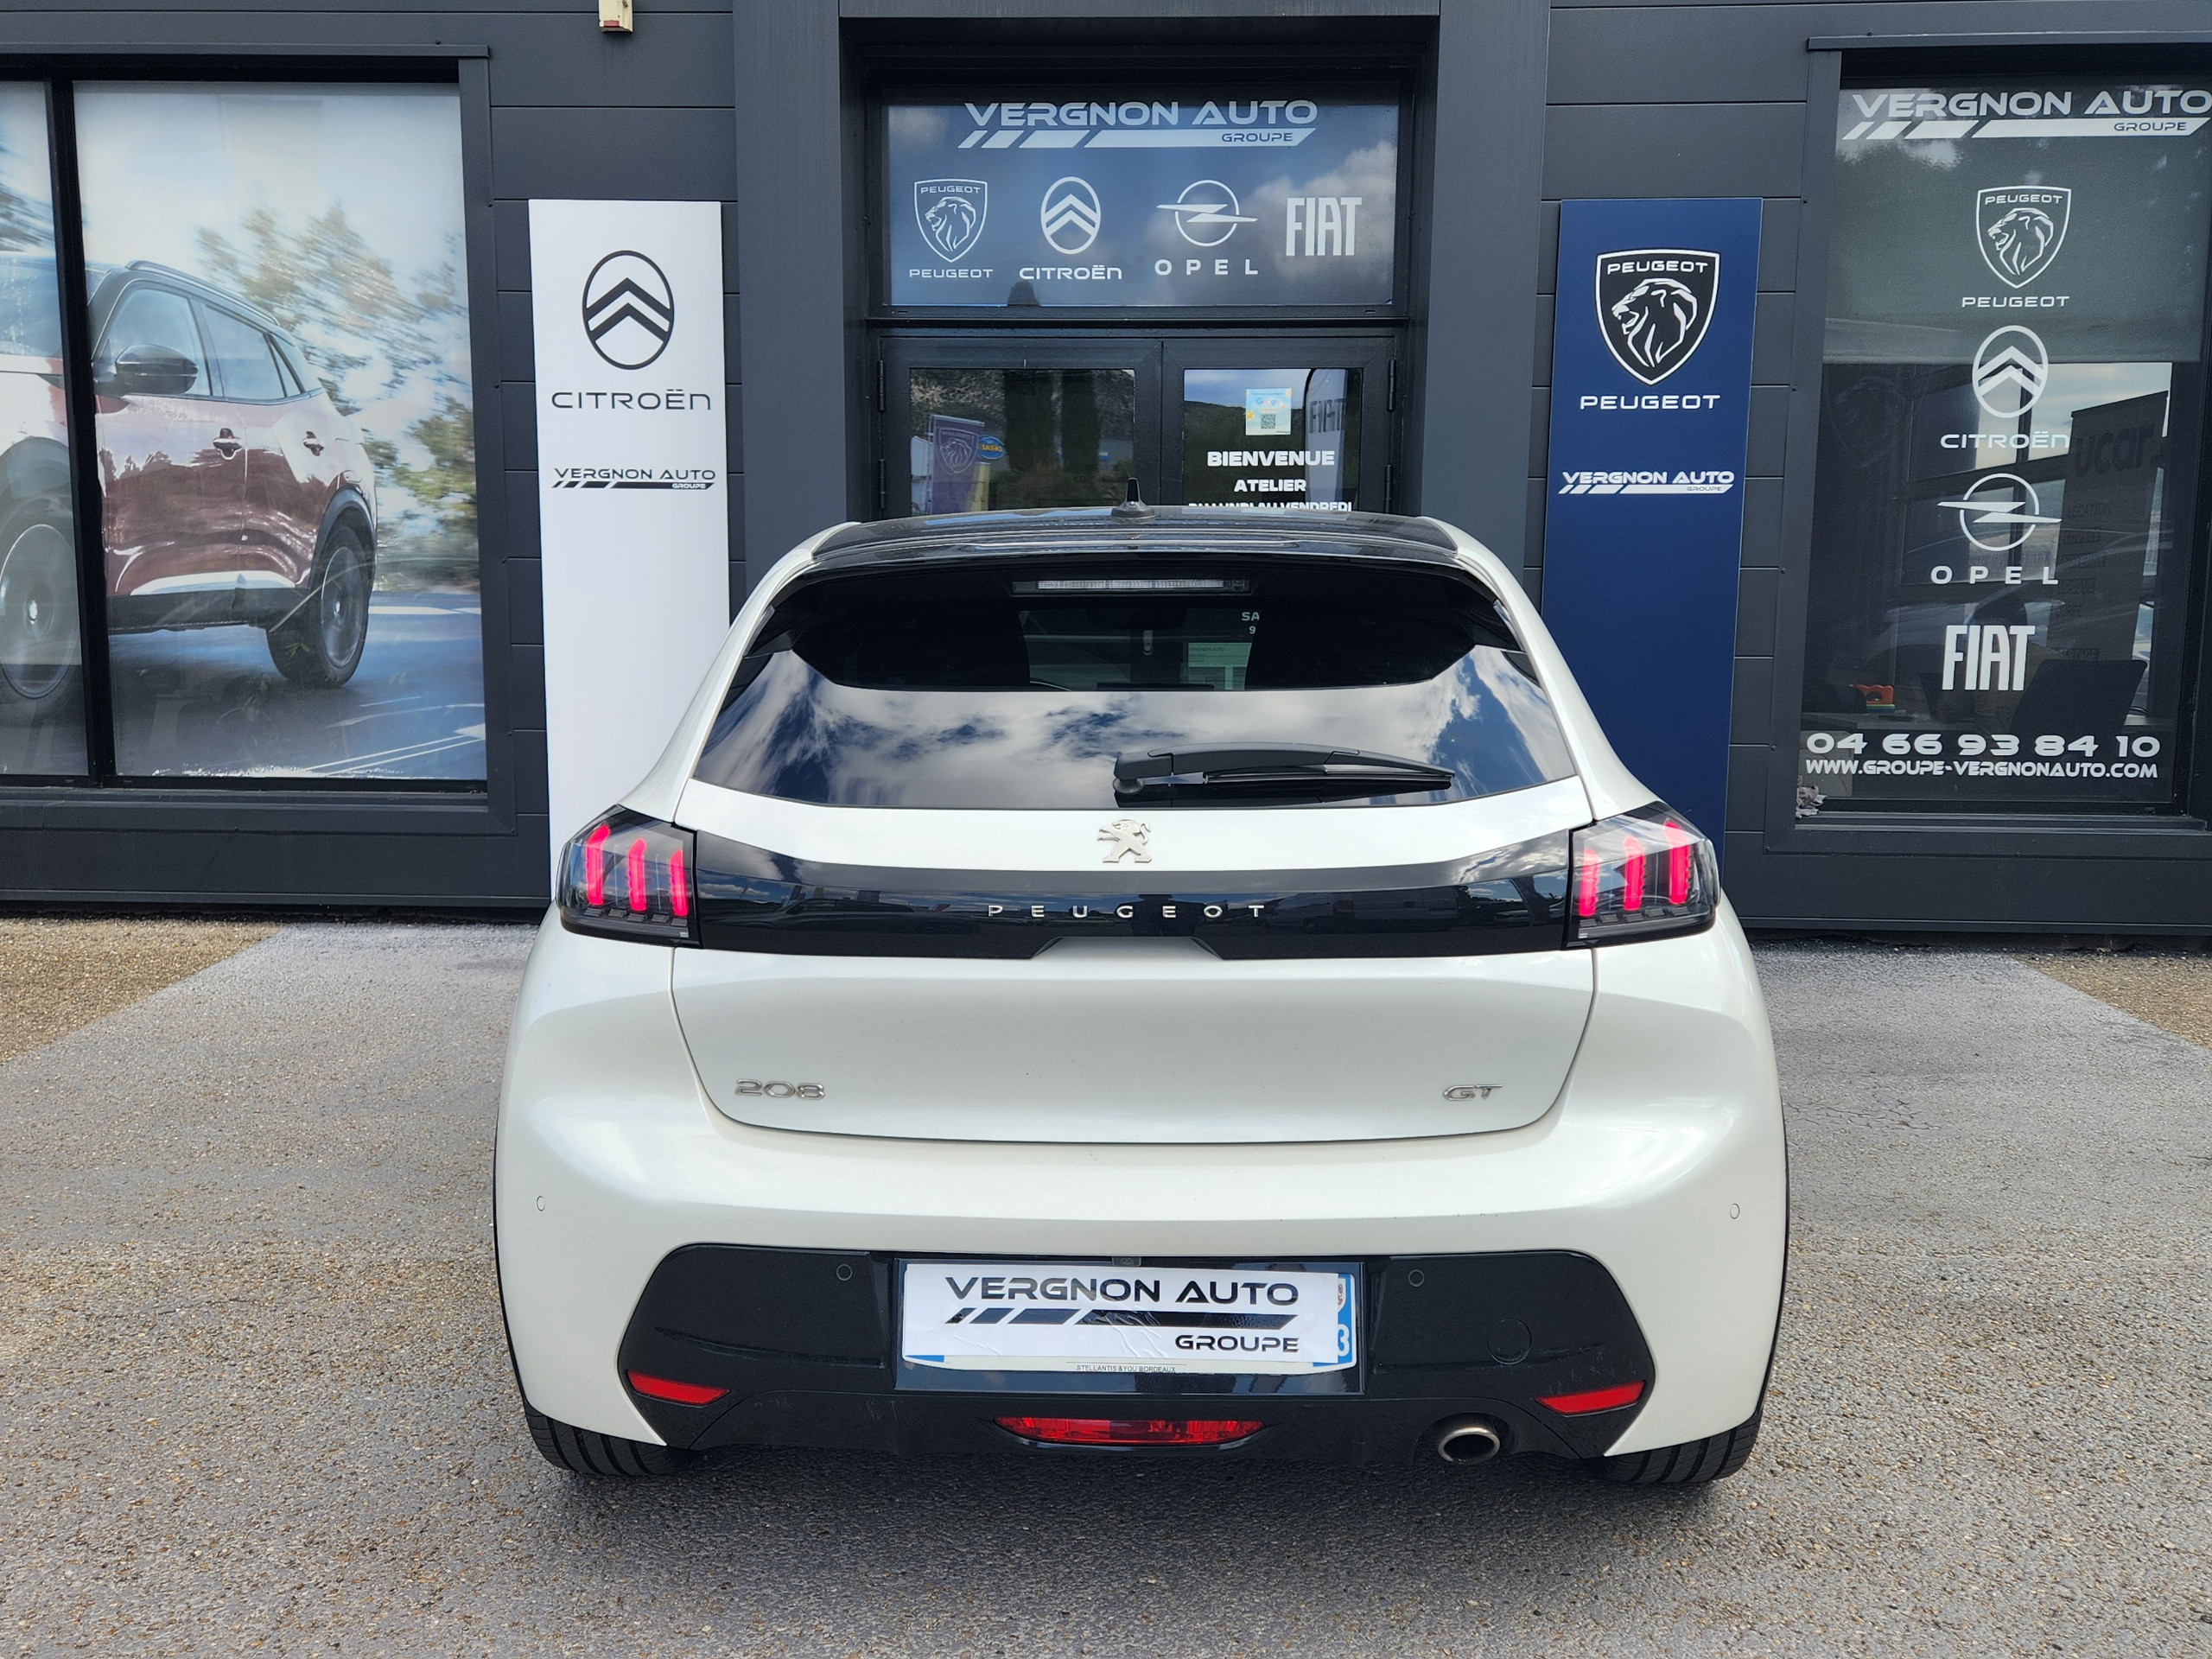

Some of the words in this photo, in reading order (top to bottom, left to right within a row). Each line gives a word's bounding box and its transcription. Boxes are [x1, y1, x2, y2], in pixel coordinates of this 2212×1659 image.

[1852, 91, 2072, 118] VERGNON
[2083, 89, 2212, 116] AUTO
[963, 101, 1179, 127] VERGNON
[1192, 99, 1319, 125] AUTO
[2113, 121, 2187, 132] GROUPE
[1221, 132, 1294, 143] GROUPE
[920, 185, 982, 194] PEUGEOT
[1985, 194, 2063, 206] PEUGEOT
[1286, 197, 1363, 257] FIAT
[909, 269, 994, 278] PEUGEOT
[1154, 258, 1259, 276] OPEL
[1607, 260, 1709, 275] PEUGEOT
[1961, 296, 2070, 308] PEUGEOT
[1256, 397, 1281, 406] Googe
[1580, 394, 1721, 410] PEUGEOT
[1207, 450, 1335, 467] BIENVENUE
[554, 467, 652, 480] VERGNON
[658, 468, 716, 480] AUTO
[1562, 471, 1668, 484] VERGNON
[1672, 471, 1735, 484] AUTO
[1234, 480, 1306, 493] ATELIER
[1930, 565, 2059, 585] OPEL
[1942, 625, 2036, 691] FIAT
[1807, 733, 1868, 754] 04
[1882, 734, 1942, 755] 66
[1957, 734, 2020, 756] 93
[2034, 734, 2100, 757] 84
[2114, 735, 2161, 758] 10
[1806, 759, 2158, 779] WWW.GROUPE-VERGNONAUTO.COM
[988, 905, 1264, 918] PEUGEOT
[734, 1079, 825, 1100] 208
[1443, 1084, 1503, 1101] GT
[944, 1276, 1160, 1302] VERGNON
[1175, 1280, 1300, 1306] AUTO
[1175, 1334, 1300, 1353] GROUPE
